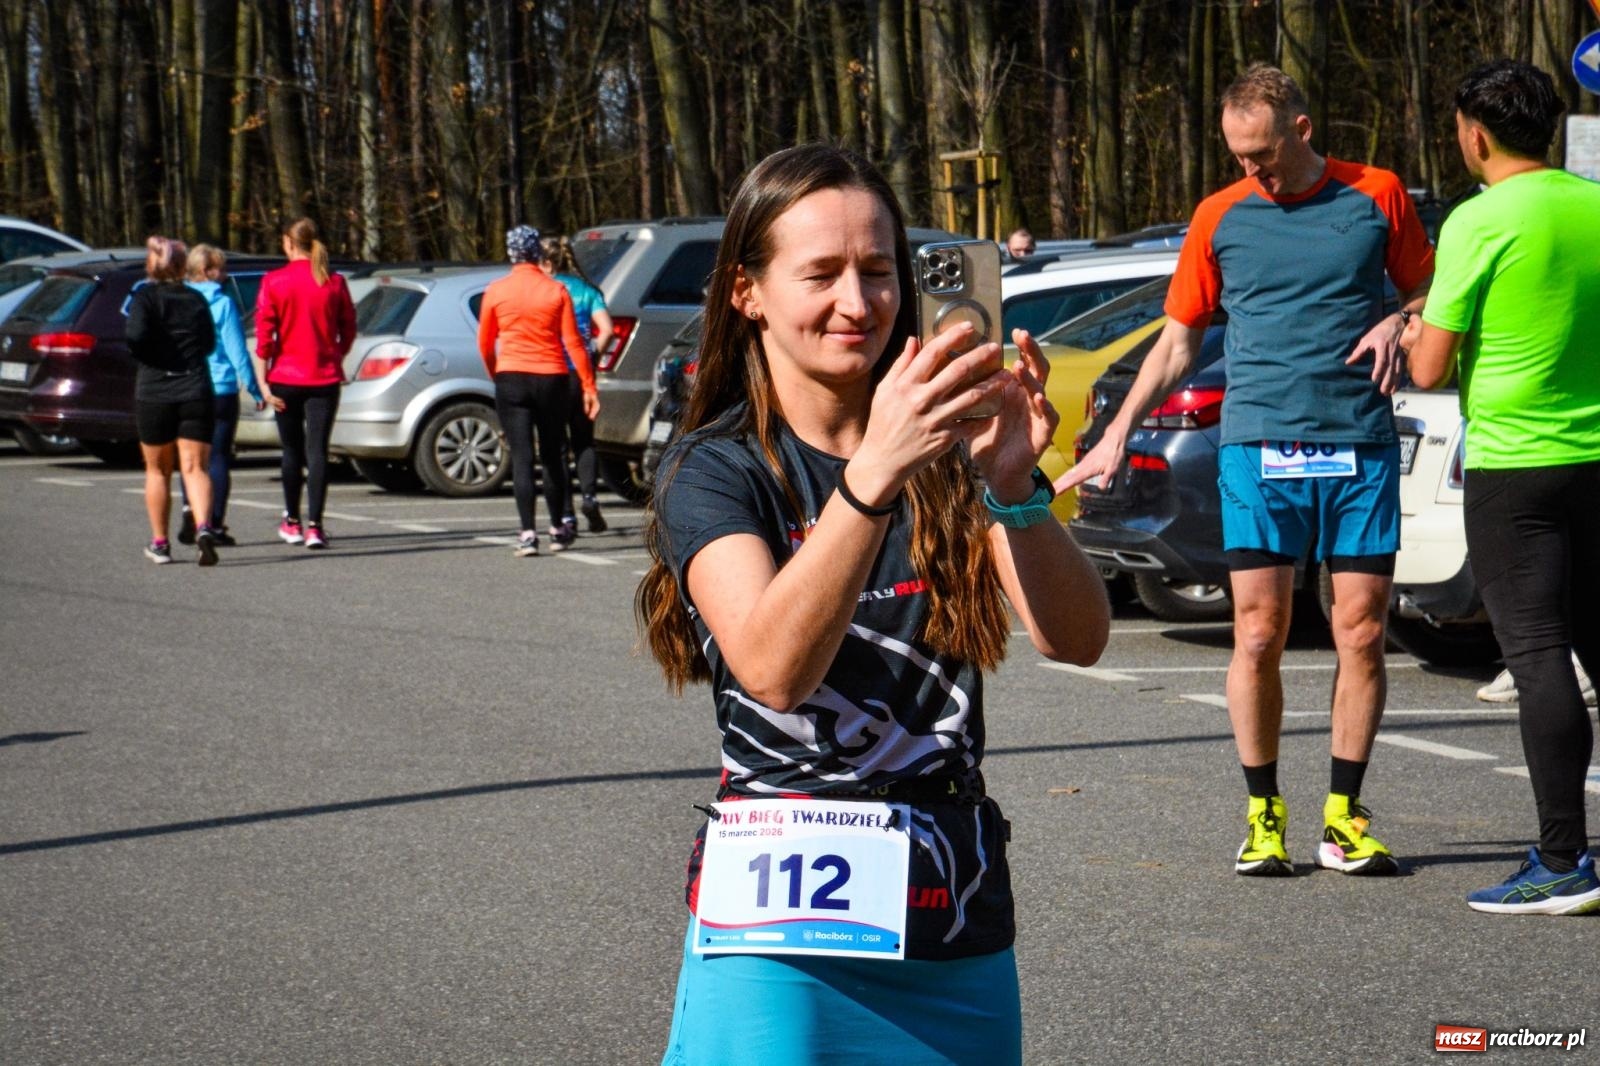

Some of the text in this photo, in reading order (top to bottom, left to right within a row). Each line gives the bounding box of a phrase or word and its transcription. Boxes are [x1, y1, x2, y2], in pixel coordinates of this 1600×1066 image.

[721, 809, 893, 829] XIV BIEG TWARDZIEL
[718, 828, 784, 839] 15 marzec 2026
[748, 853, 851, 911] 112
[815, 931, 854, 942] Racibórz
